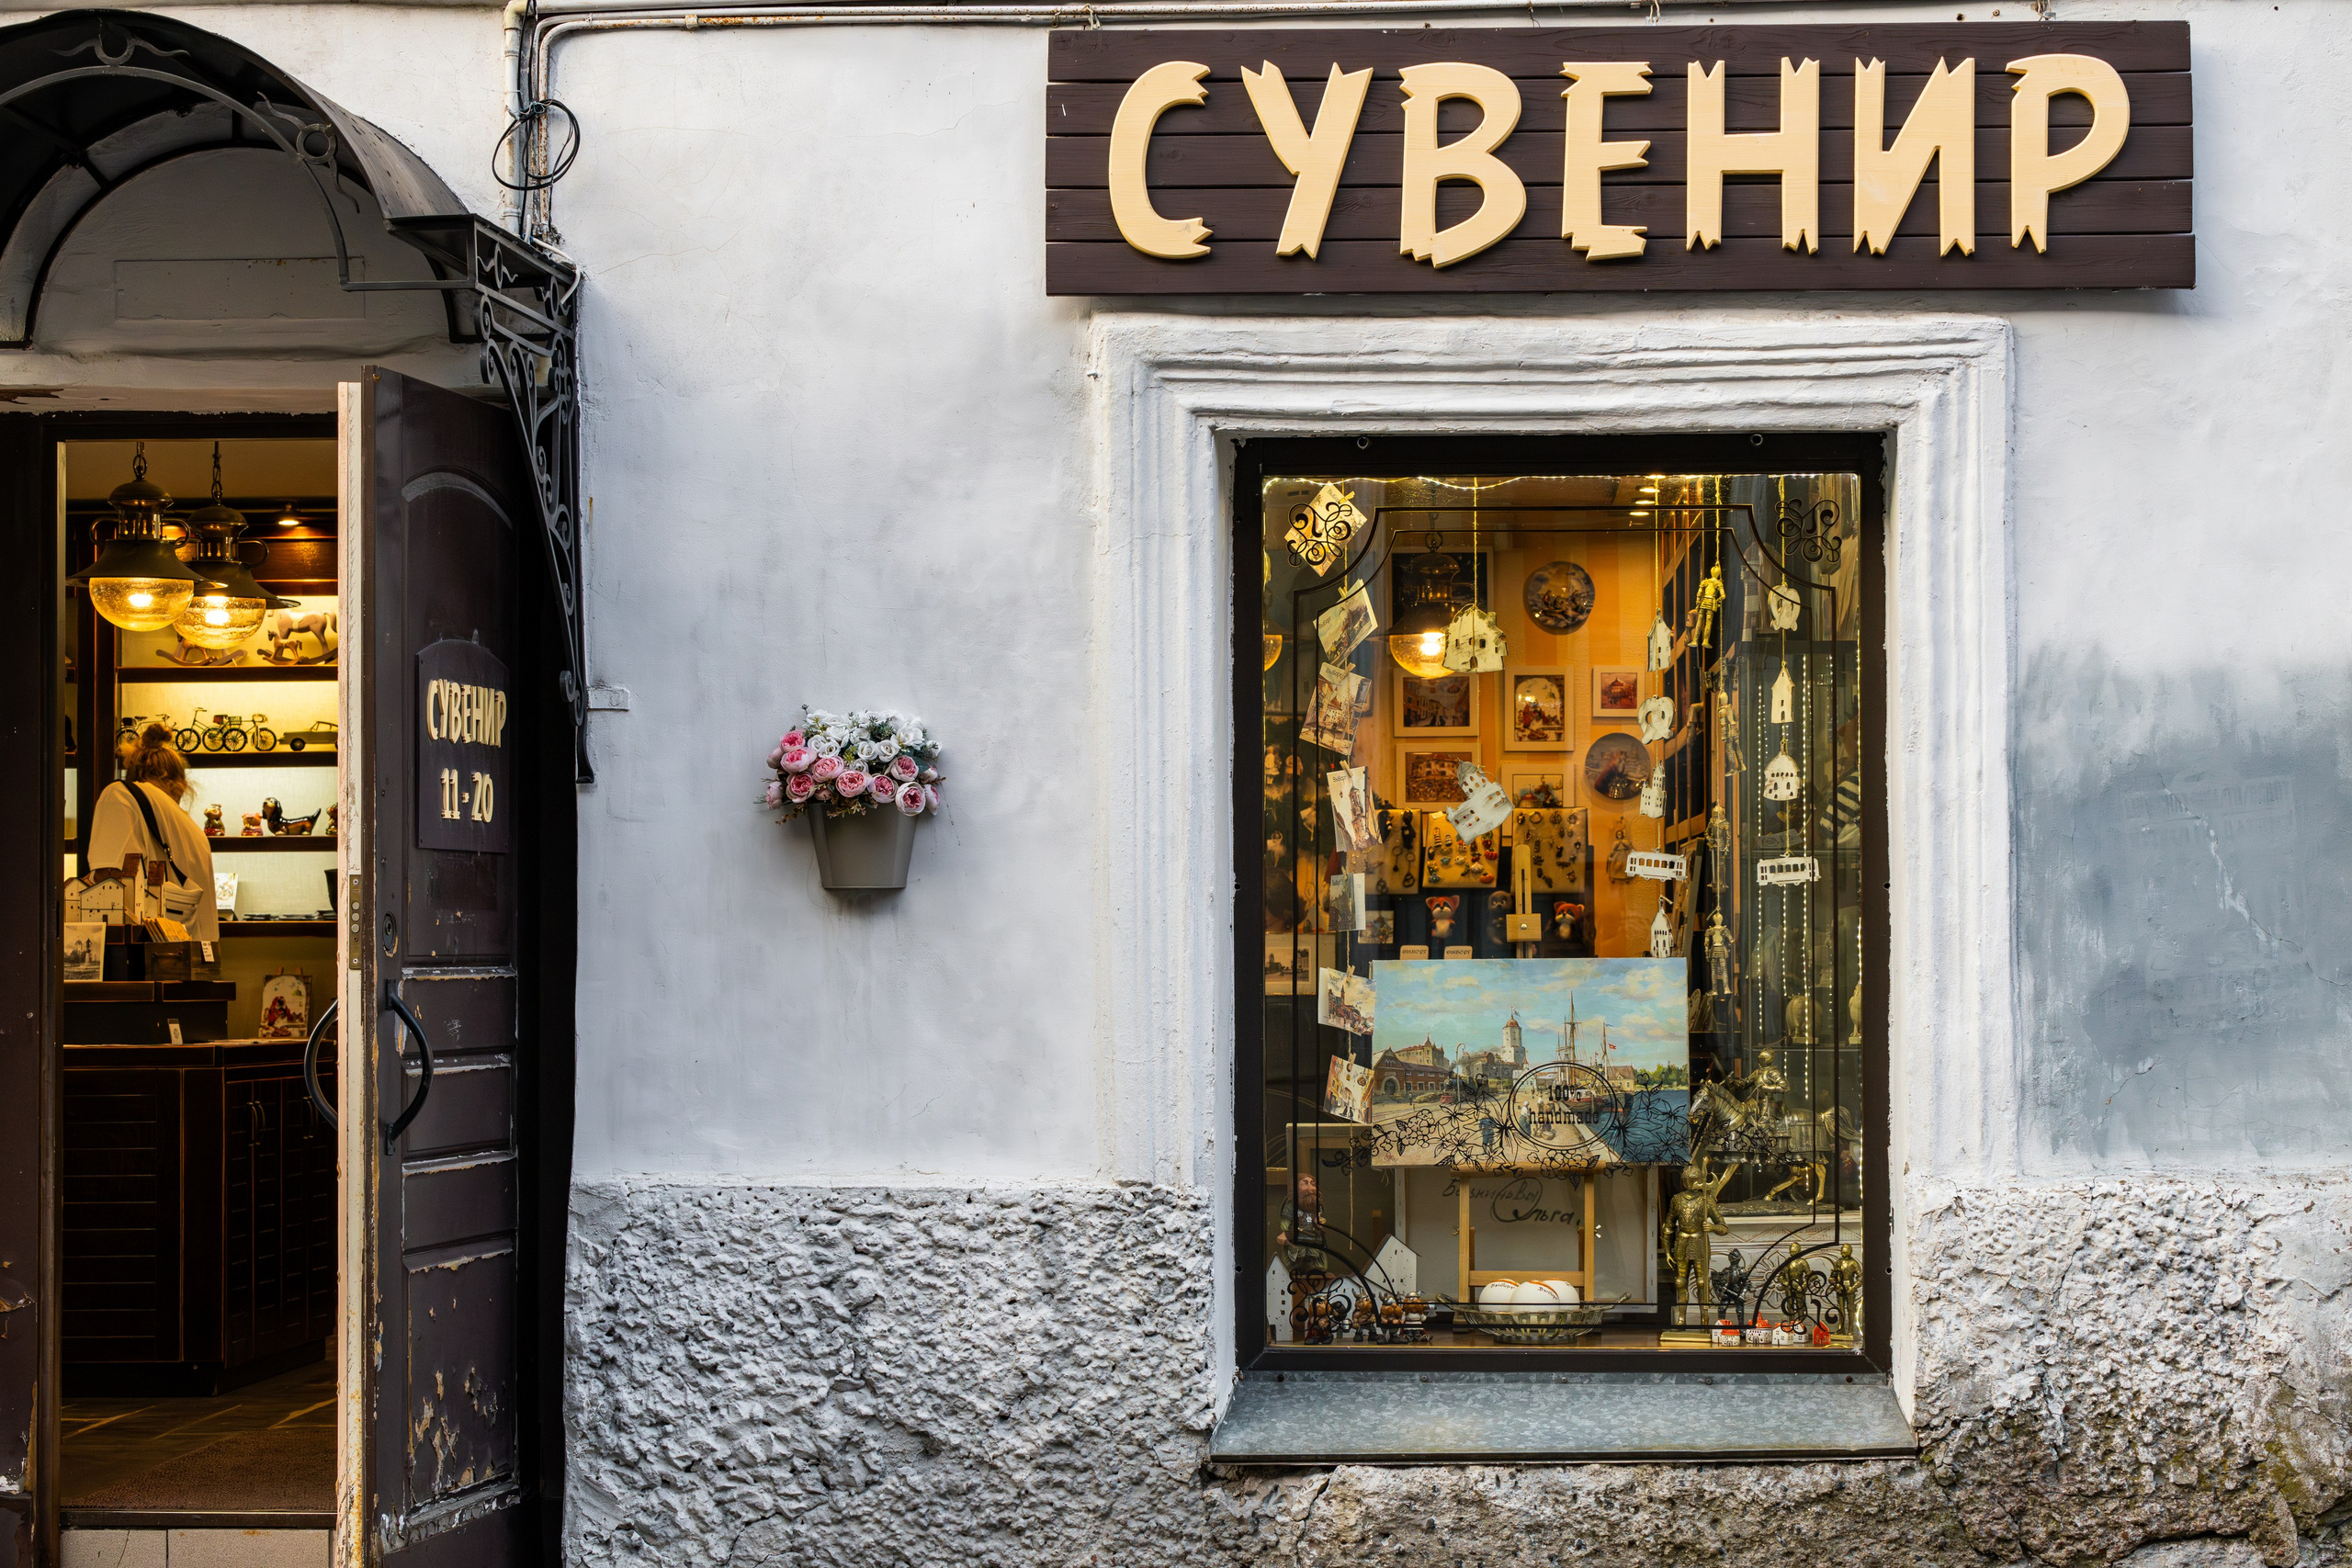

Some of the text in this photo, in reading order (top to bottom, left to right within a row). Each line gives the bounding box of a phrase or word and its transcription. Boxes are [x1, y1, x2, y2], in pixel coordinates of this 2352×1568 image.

[1108, 53, 2132, 269] СУВЕНИР
[426, 679, 507, 748] СУВЕНИР
[1548, 1085, 1581, 1101] 100%
[1529, 1108, 1600, 1125] handmade
